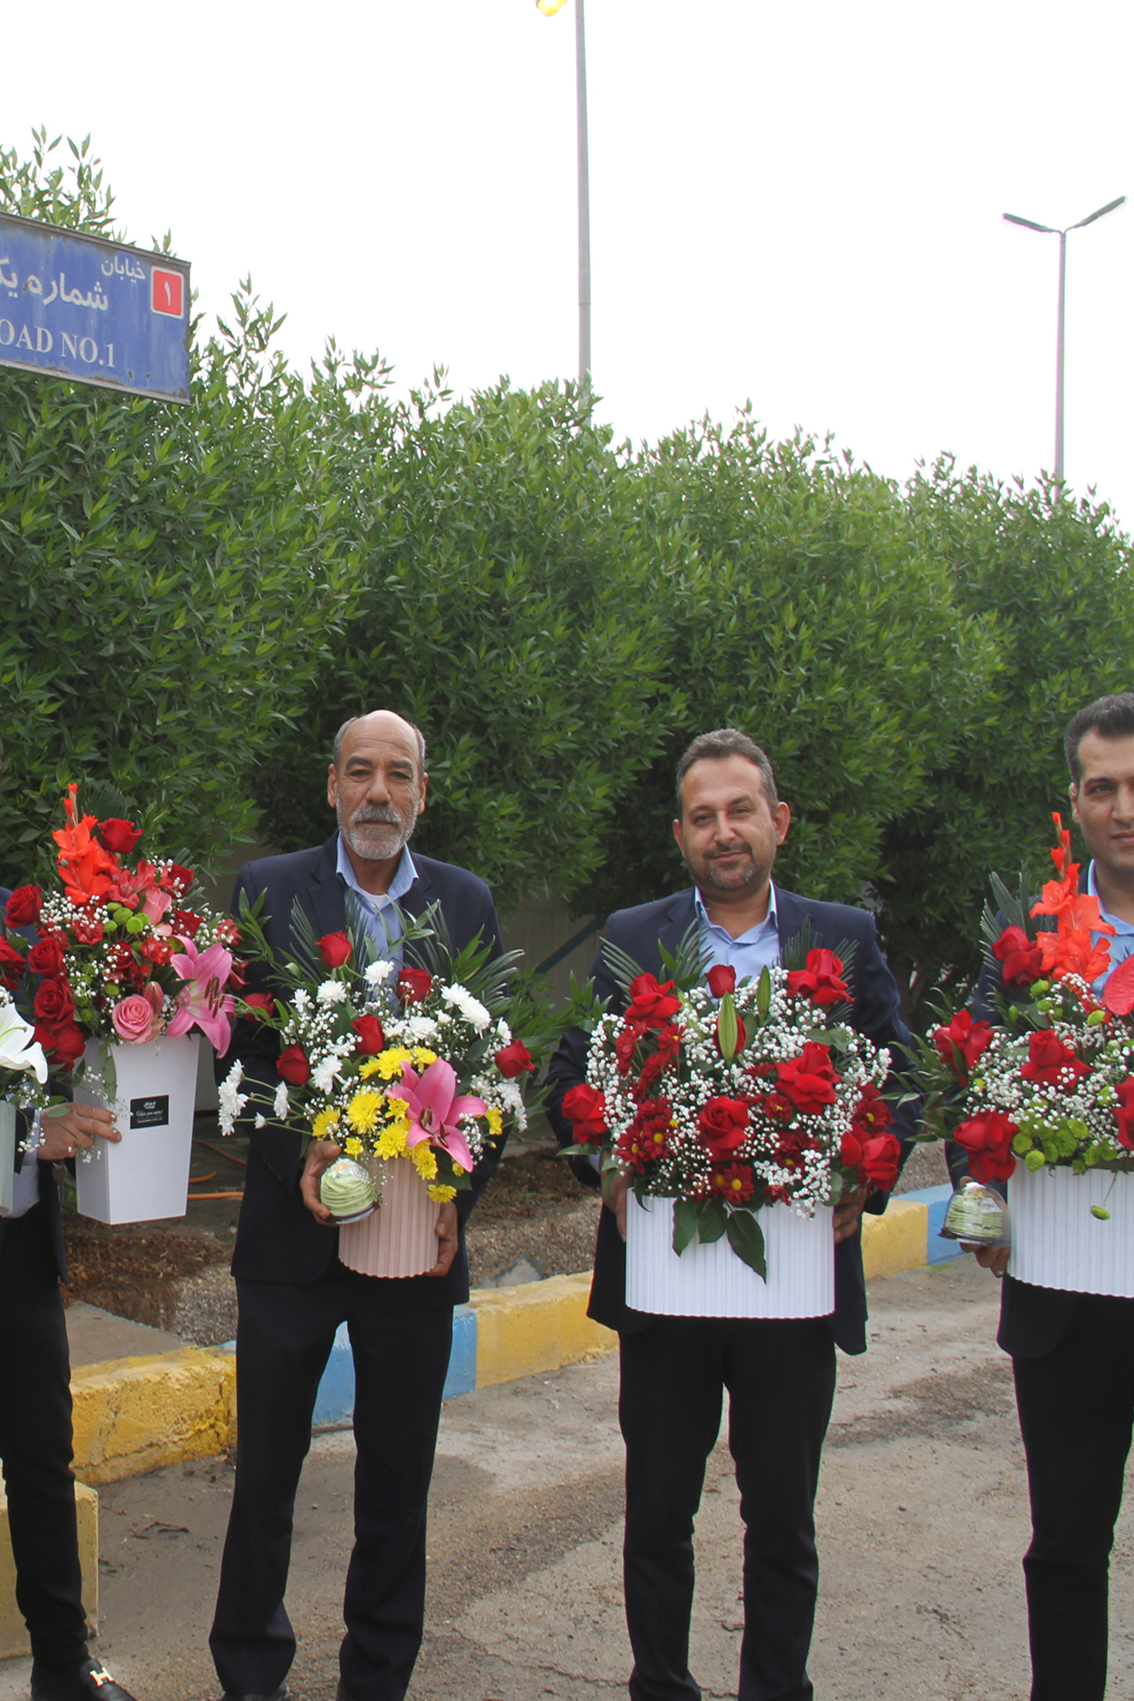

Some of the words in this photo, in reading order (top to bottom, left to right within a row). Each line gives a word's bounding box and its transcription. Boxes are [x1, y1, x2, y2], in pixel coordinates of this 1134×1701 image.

[100, 255, 147, 283] خیابان
[26, 271, 110, 312] شماره
[60, 331, 115, 368] NO.1
